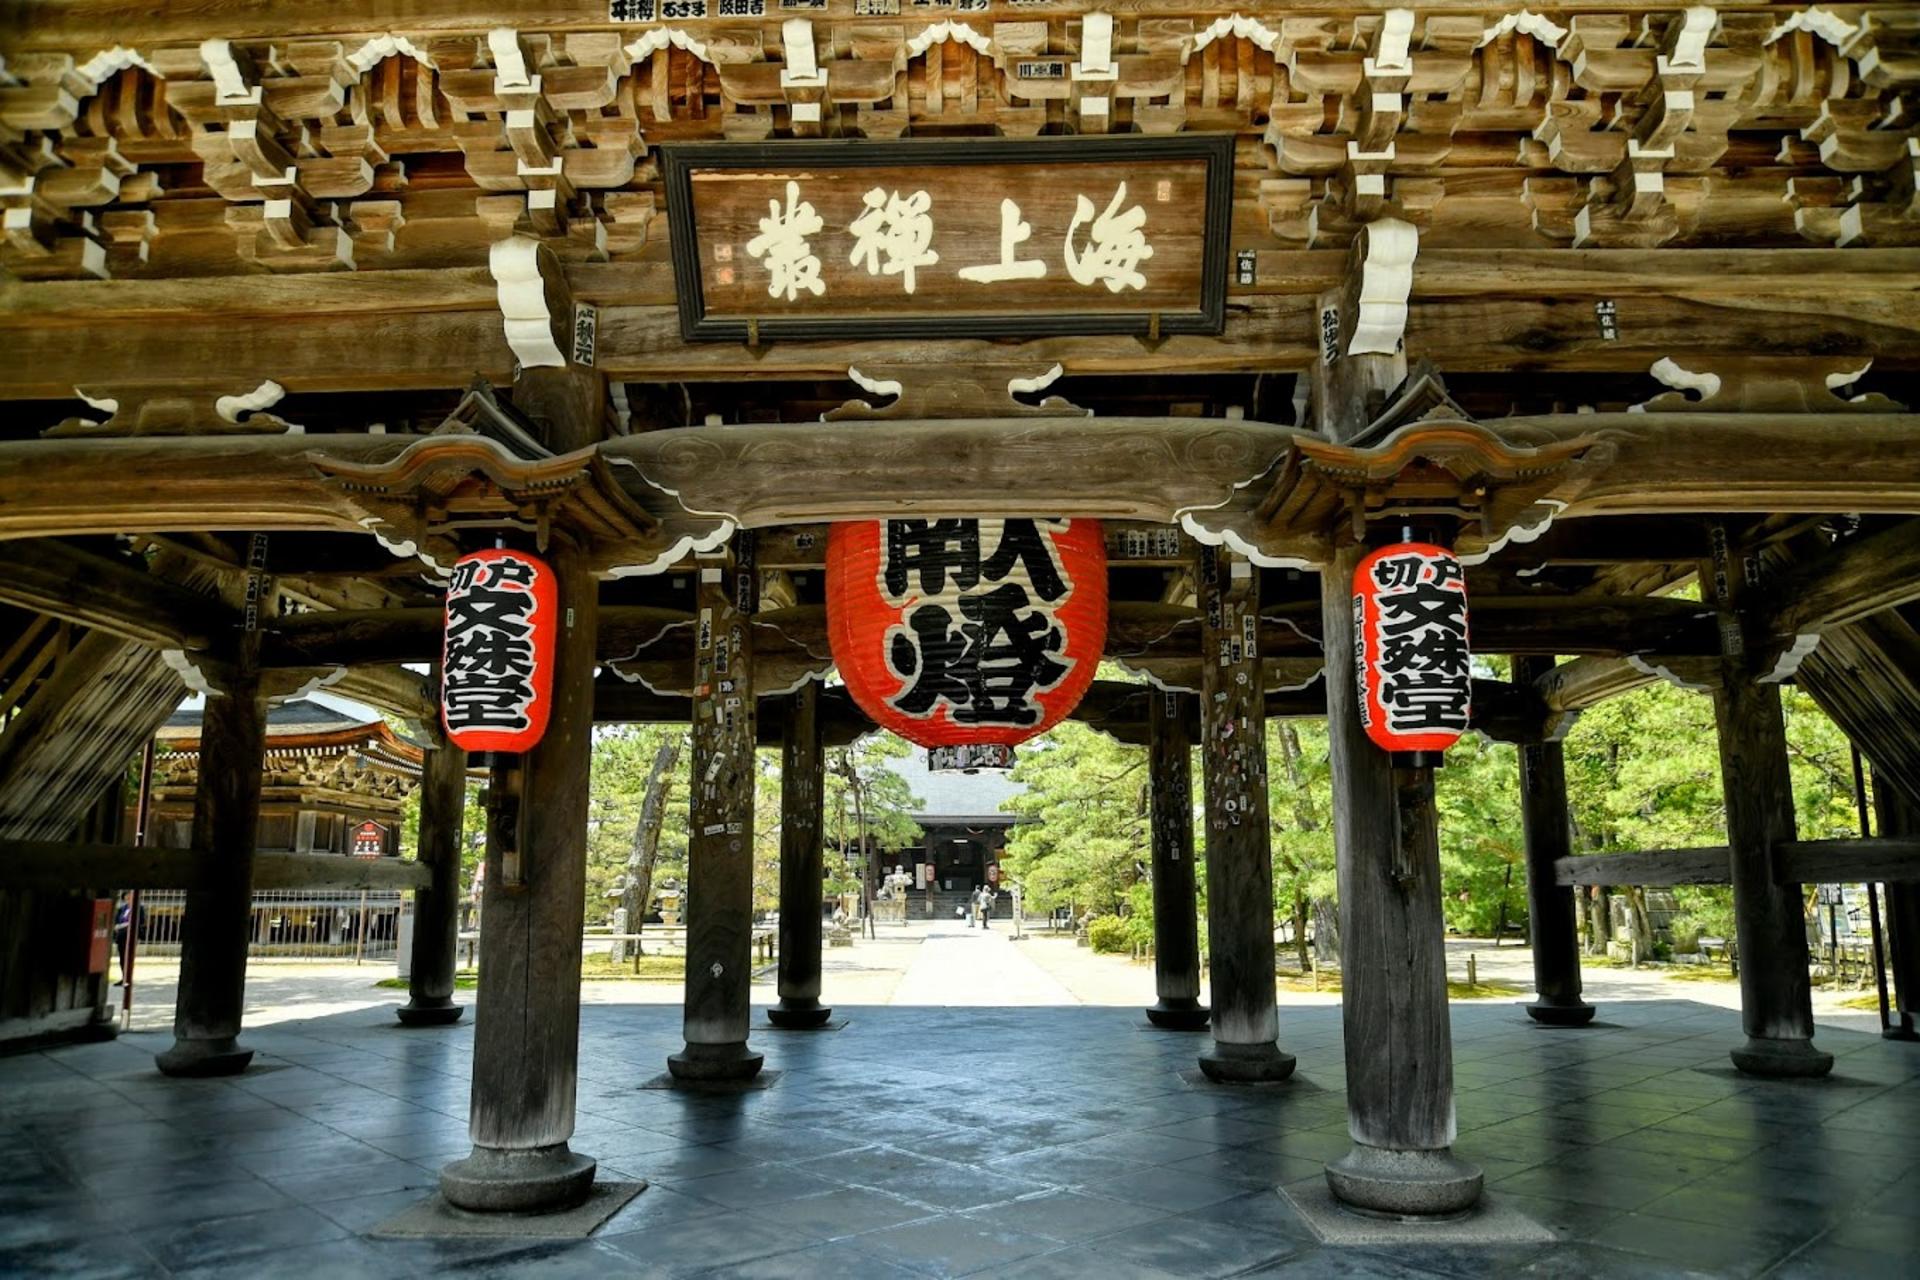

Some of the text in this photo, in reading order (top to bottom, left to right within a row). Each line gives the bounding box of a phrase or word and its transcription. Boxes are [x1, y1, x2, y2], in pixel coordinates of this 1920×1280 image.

[444, 588, 535, 731] 文殊堂
[1380, 584, 1469, 731] 文殊堂
